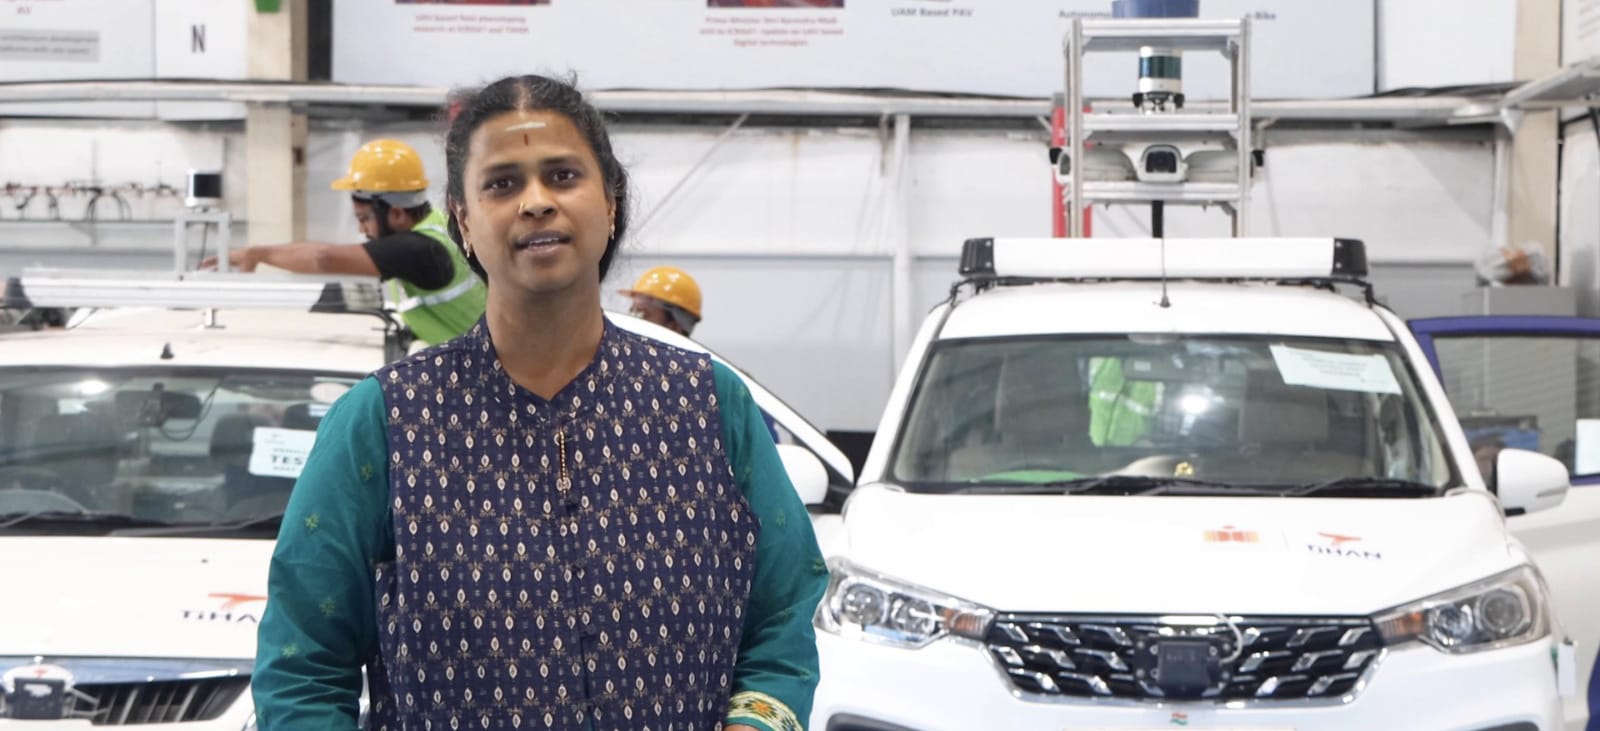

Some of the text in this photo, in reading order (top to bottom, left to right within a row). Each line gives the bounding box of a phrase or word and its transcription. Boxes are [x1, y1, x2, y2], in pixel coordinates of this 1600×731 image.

[920, 7, 949, 17] Based
[191, 24, 206, 53] N
[271, 455, 304, 465] TES
[180, 609, 257, 623] TiHA
